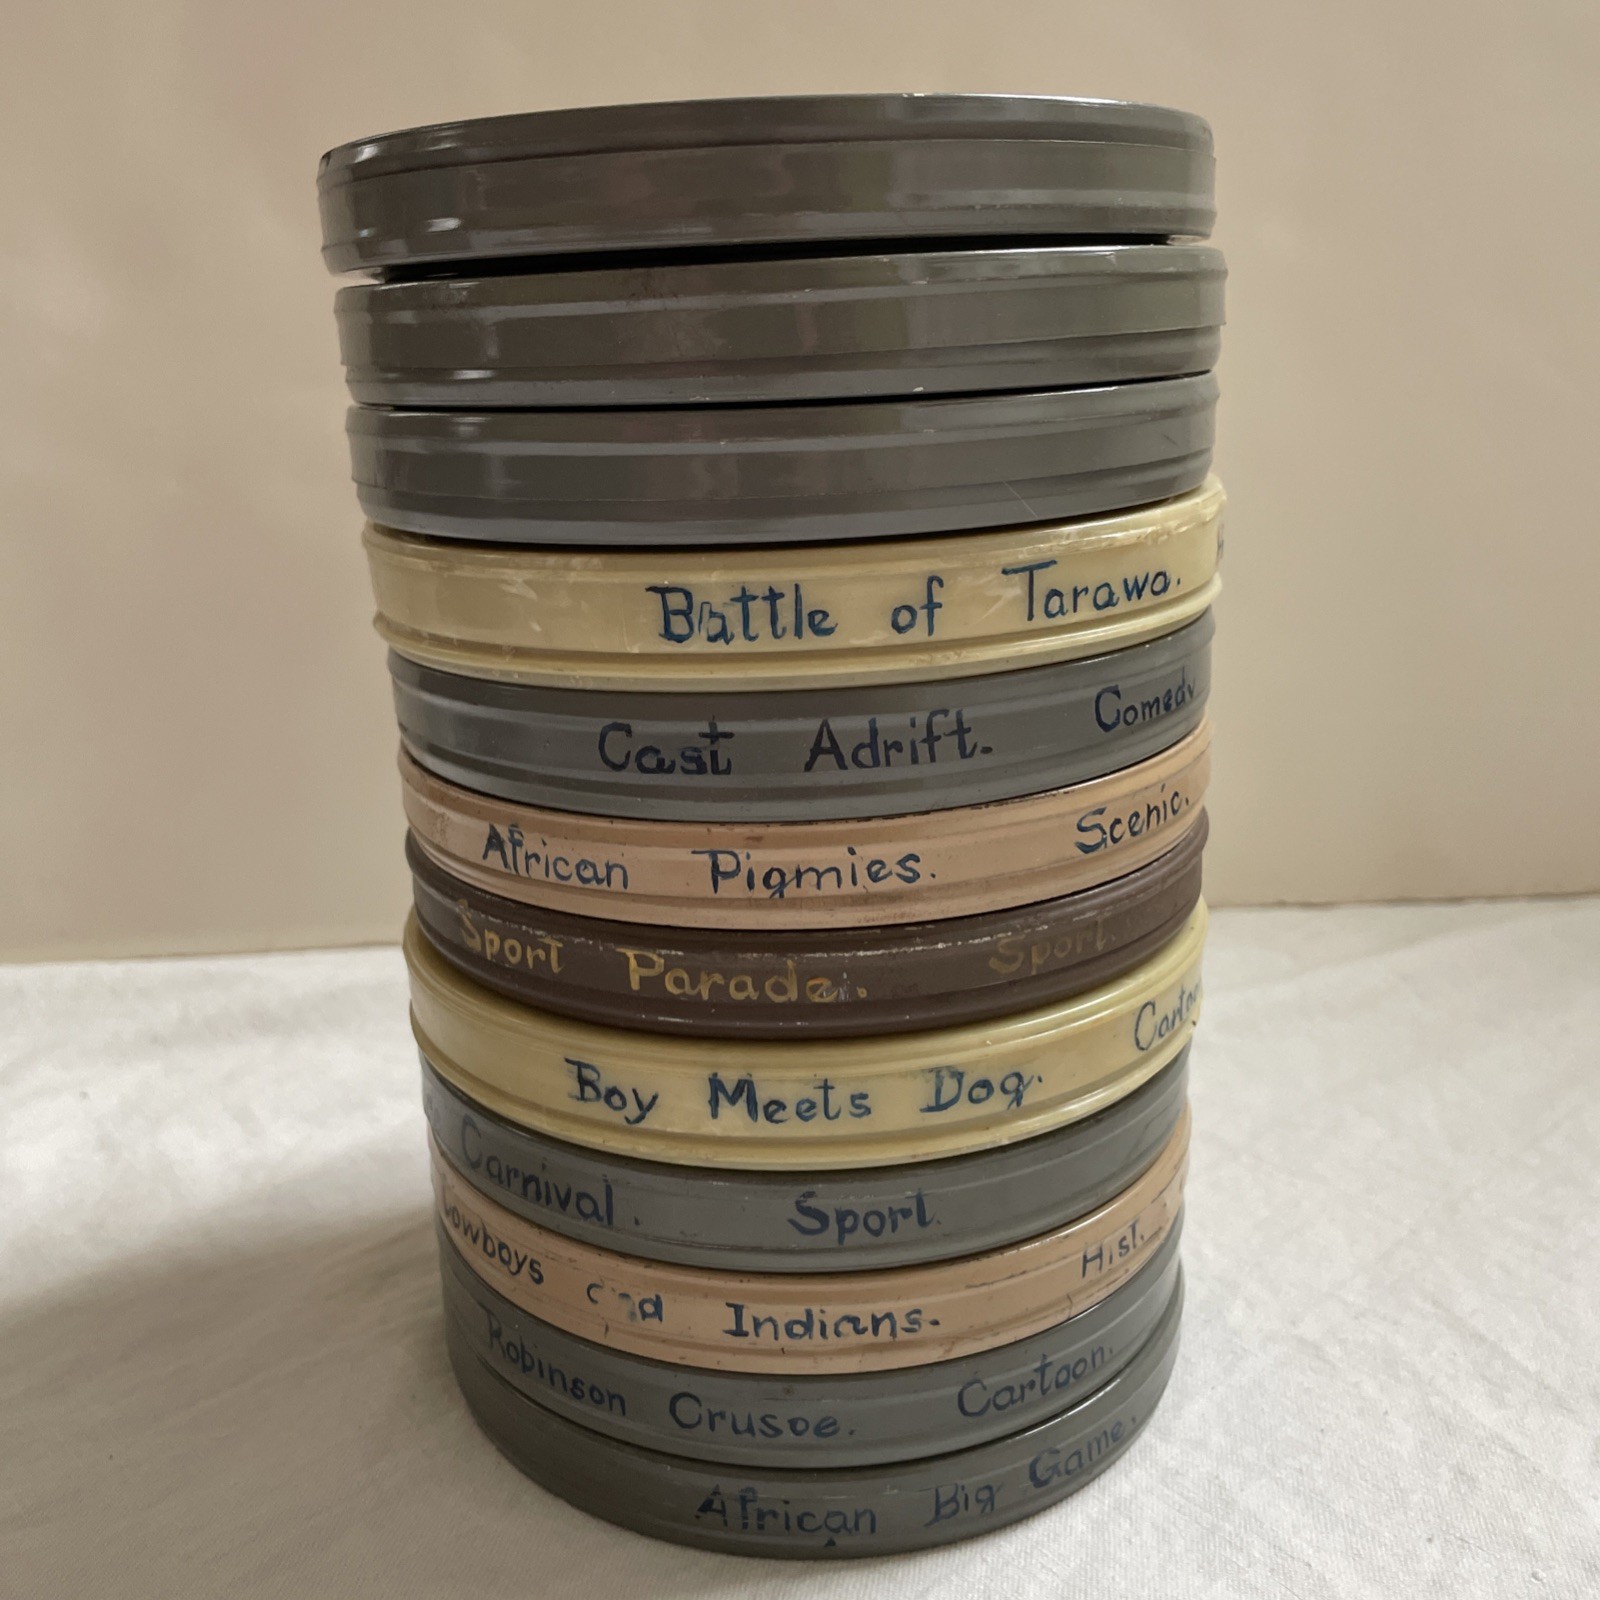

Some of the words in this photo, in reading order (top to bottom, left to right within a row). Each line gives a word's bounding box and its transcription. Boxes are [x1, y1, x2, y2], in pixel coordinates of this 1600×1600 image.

[645, 583, 838, 645] Battle
[891, 575, 944, 636] of
[1002, 560, 1181, 621] Tarawa.
[598, 716, 735, 775] Cast
[804, 708, 993, 771] Adrift.
[482, 823, 629, 890] African
[691, 846, 936, 899] Pigmies.
[1074, 784, 1189, 854] Scenic.
[458, 899, 565, 974] Sport
[615, 949, 867, 1003] Parade.
[564, 1057, 659, 1125] Boy
[708, 1072, 871, 1124] Meets
[920, 1065, 1043, 1113] Dog.
[722, 1302, 940, 1341] Indians.
[1082, 1219, 1145, 1278] Hist.
[479, 1302, 626, 1416] Robinson
[669, 1391, 856, 1438] Crusoe.
[957, 1345, 1114, 1417] Cartoon.
[695, 1483, 876, 1535] African
[925, 1482, 1004, 1527] Big
[1029, 1415, 1137, 1488] Game.
